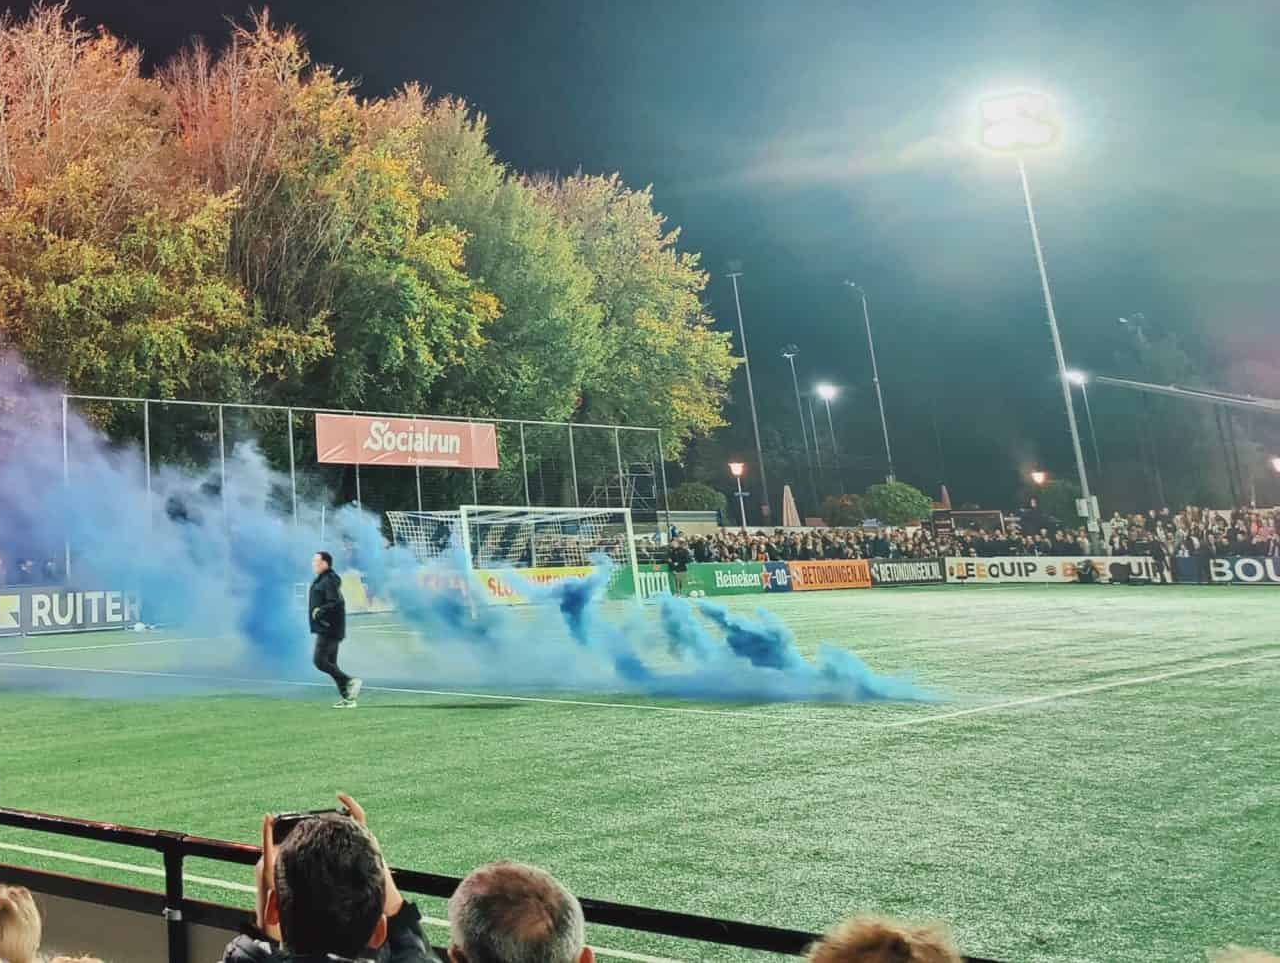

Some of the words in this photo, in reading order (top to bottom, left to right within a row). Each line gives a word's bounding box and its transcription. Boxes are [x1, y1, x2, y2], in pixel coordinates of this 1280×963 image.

[363, 421, 460, 454] Socialrun
[715, 570, 760, 587] Heineken
[802, 565, 869, 584] BETONDINGEN.NL
